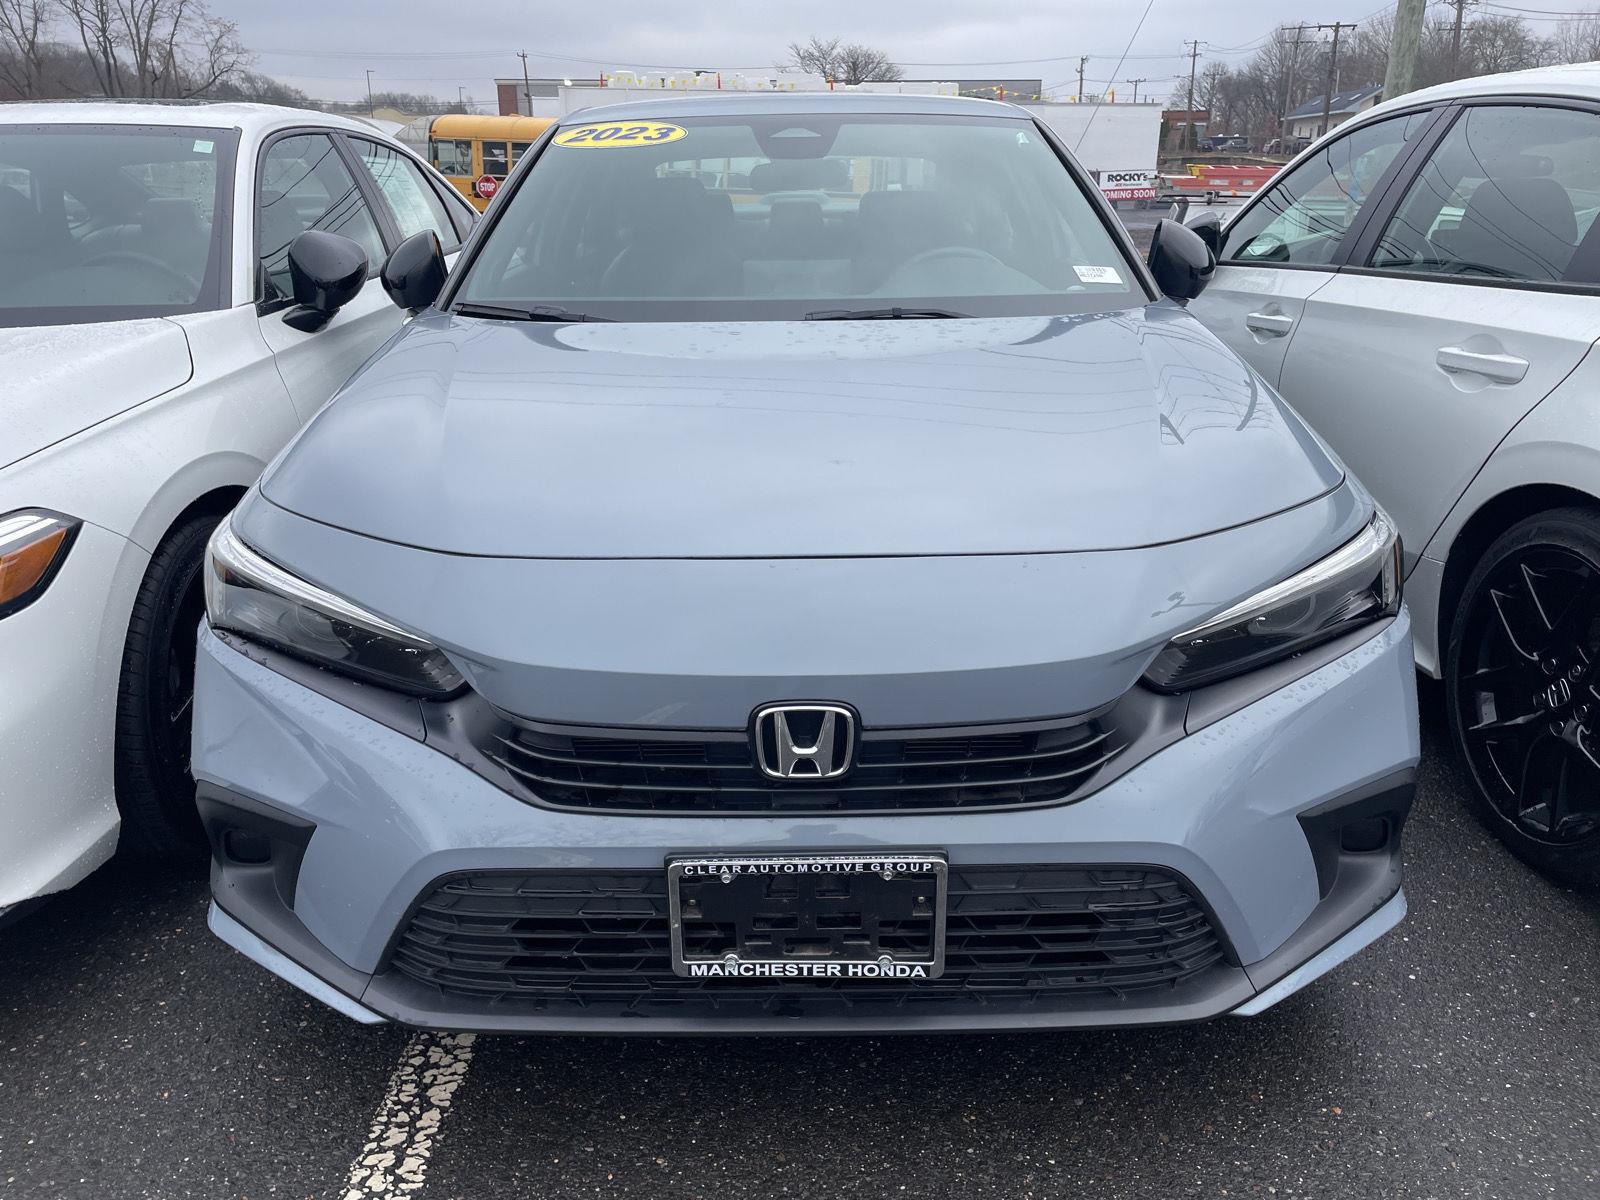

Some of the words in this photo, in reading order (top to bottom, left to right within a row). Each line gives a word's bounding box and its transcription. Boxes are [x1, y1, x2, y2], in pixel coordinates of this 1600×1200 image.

[563, 126, 677, 143] 2023
[480, 183, 496, 191] STOP
[1104, 190, 1131, 199] OMING
[1133, 189, 1156, 198] SOON
[684, 865, 742, 875] CLEAR
[748, 862, 864, 873] AUTOMOTIVE
[870, 862, 932, 872] GROUP
[690, 963, 842, 976] MANCHESTER
[848, 963, 927, 977] HONDA
